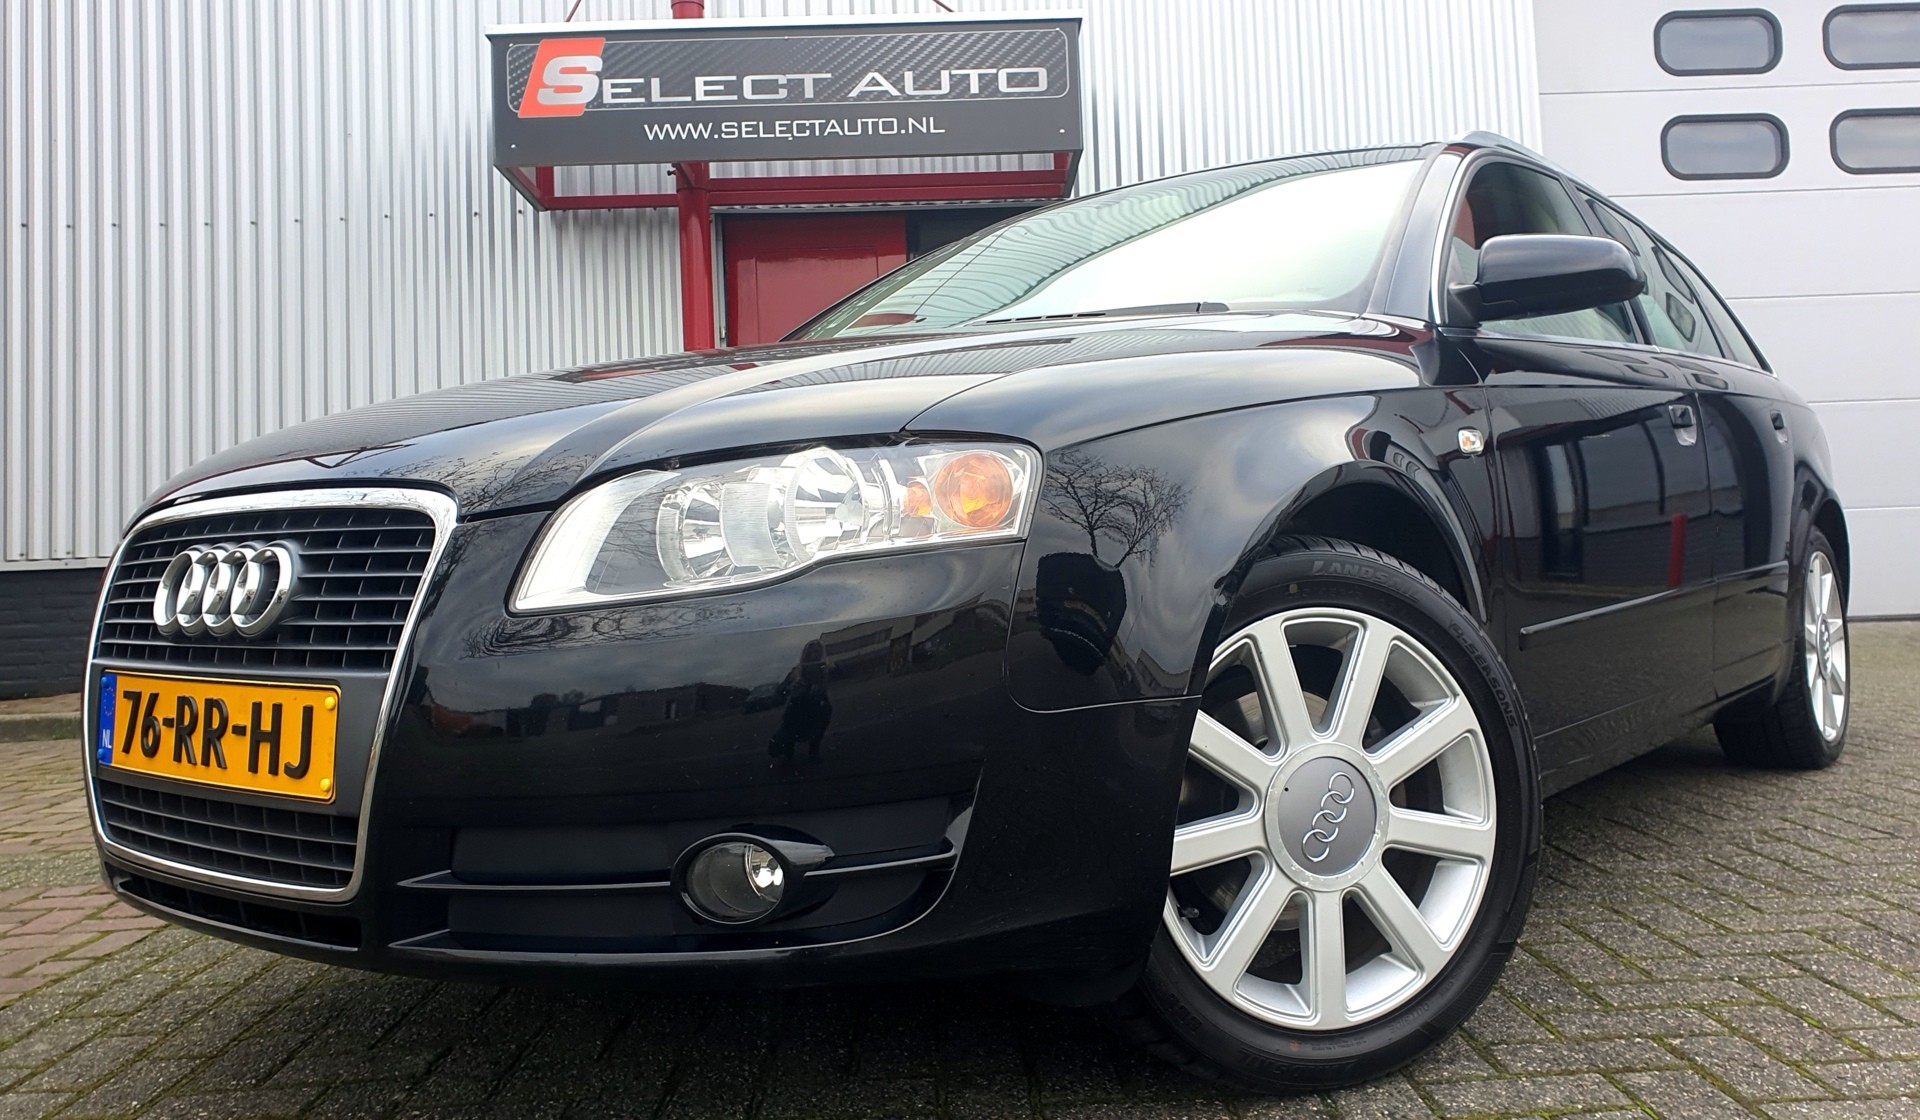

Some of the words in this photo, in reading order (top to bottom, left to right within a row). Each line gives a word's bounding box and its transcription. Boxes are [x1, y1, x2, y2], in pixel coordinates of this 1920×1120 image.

[537, 55, 832, 105] SELECT
[847, 67, 1048, 98] AUTO
[644, 117, 946, 141] WWW.SELECTAUTO.NL
[102, 728, 112, 749] NL
[121, 690, 314, 779] 76-RR-HJ
